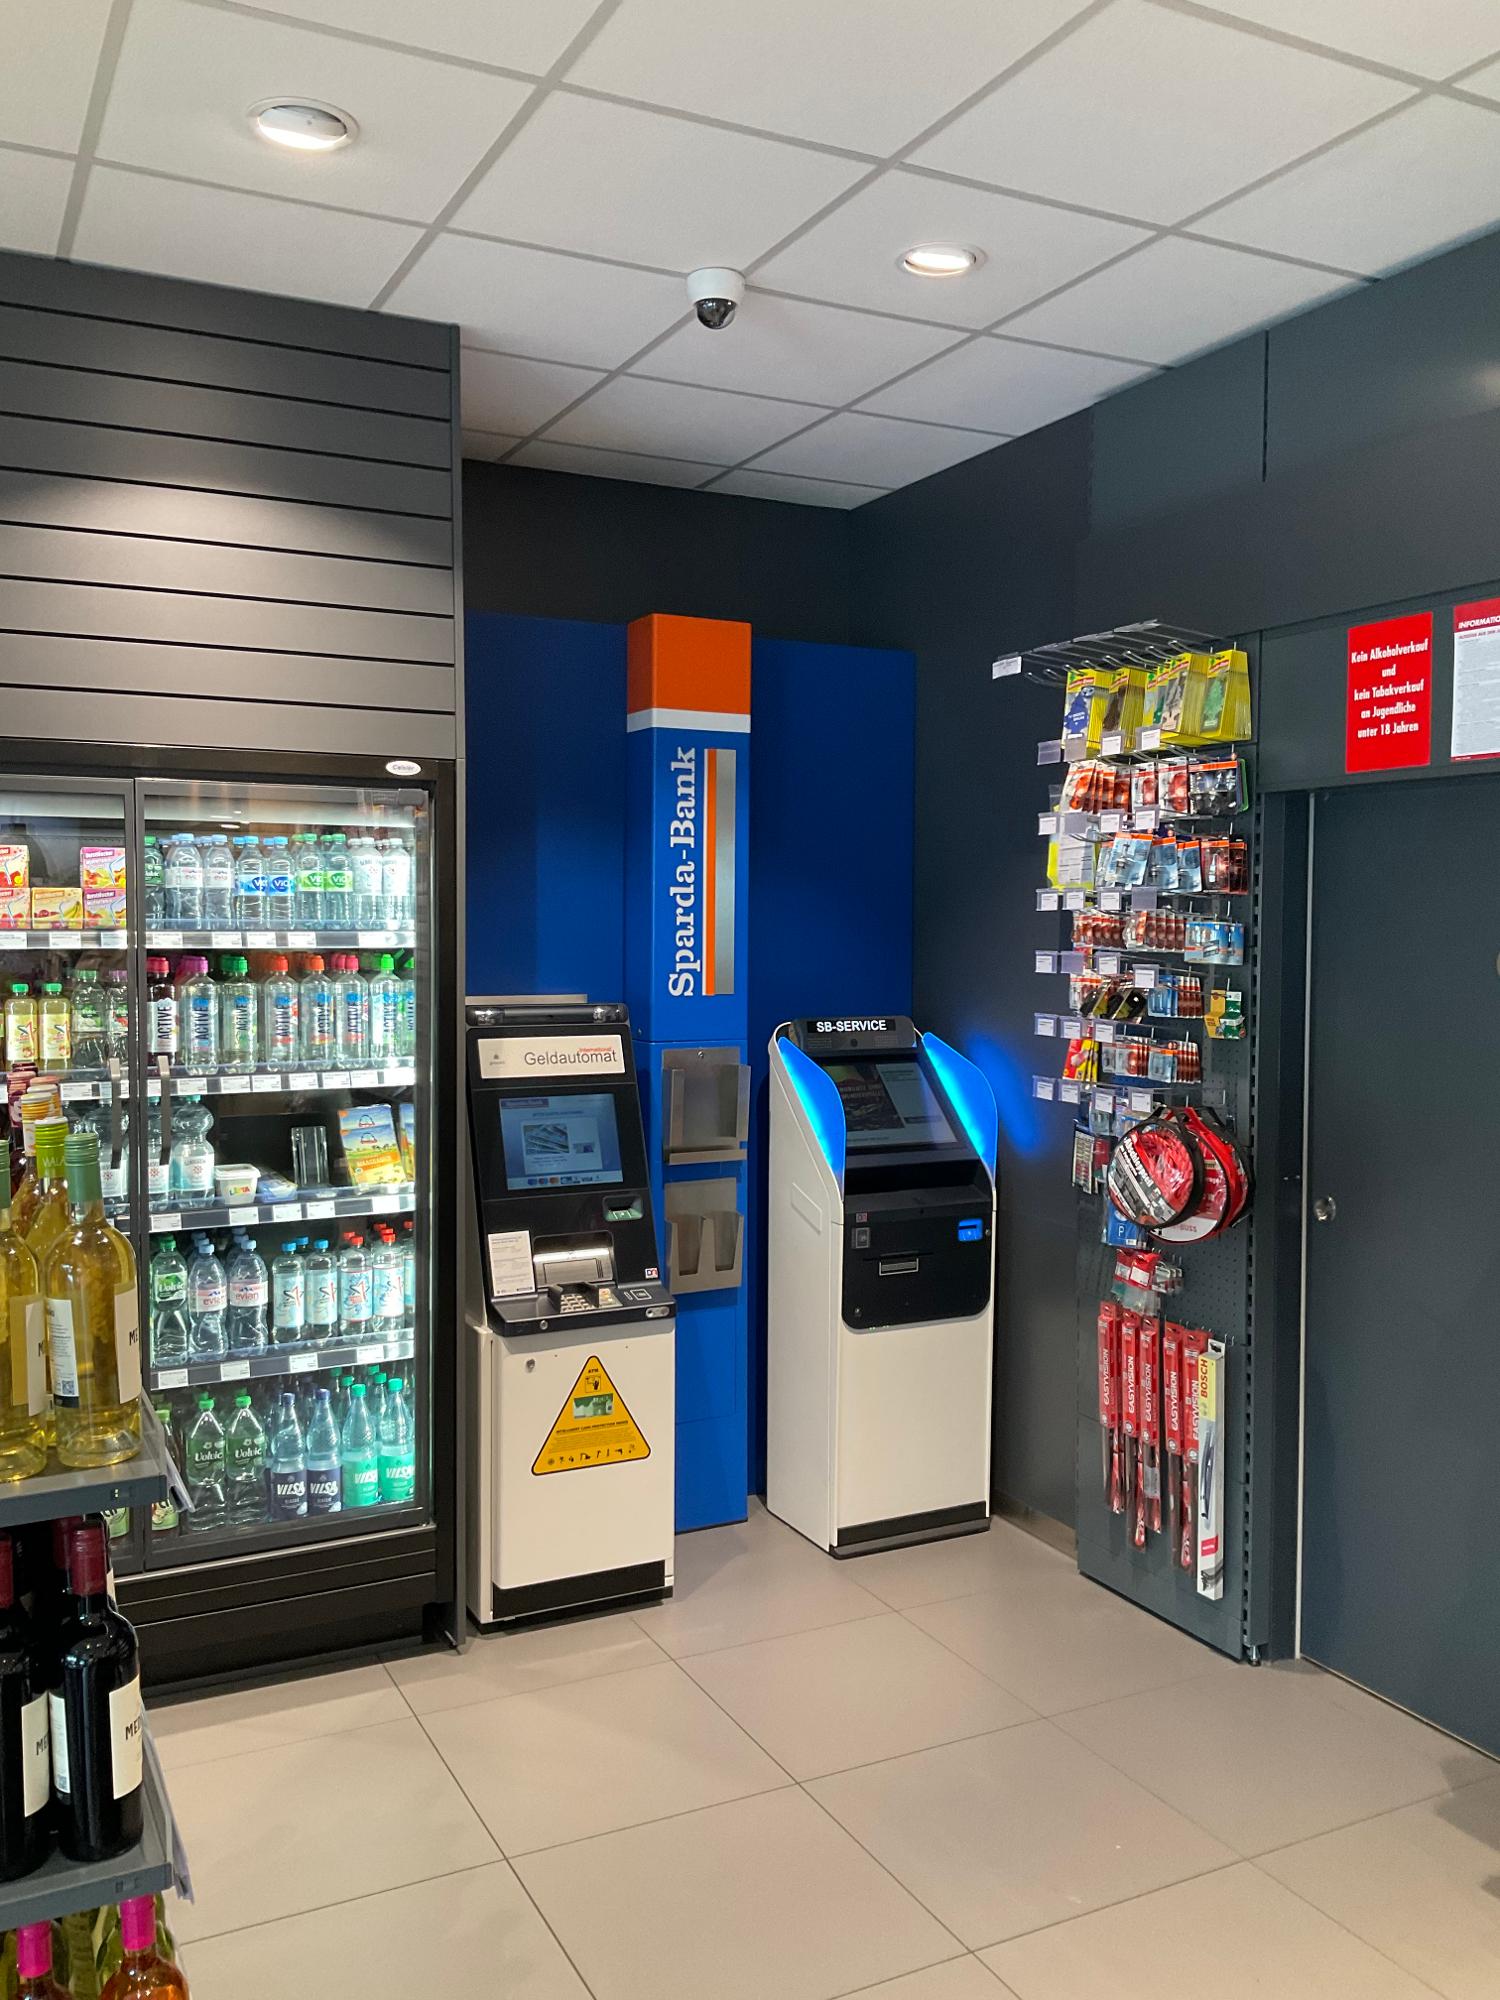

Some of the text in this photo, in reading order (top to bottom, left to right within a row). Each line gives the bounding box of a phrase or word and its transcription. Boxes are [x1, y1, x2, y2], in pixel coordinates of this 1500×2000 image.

[1351, 637, 1429, 664] Kein Alkoholverkauf
[1381, 664, 1396, 677] und
[1354, 678, 1425, 701] kein Tabakverkauf
[1361, 700, 1416, 719] an Jugendliche
[1357, 720, 1419, 739] unter 18 Jahren
[668, 746, 701, 997] Sparda-Bank
[157, 1005, 172, 1040] ACTIVE
[195, 1006, 209, 1041] ACTIVE
[236, 1004, 248, 1031] ACTIVE
[276, 1004, 290, 1037] ACTIVE
[816, 1019, 887, 1033] SB-SERVICE
[524, 1049, 618, 1066] Geldautomat
[1117, 1225, 1125, 1237] P
[235, 1291, 259, 1300] evian
[1200, 1358, 1208, 1399] BOSCH
[1170, 1371, 1178, 1431] EASYVISION
[234, 1447, 262, 1459] Volvic
[277, 1481, 305, 1496] VILSA
[310, 1480, 339, 1496] VILSA
